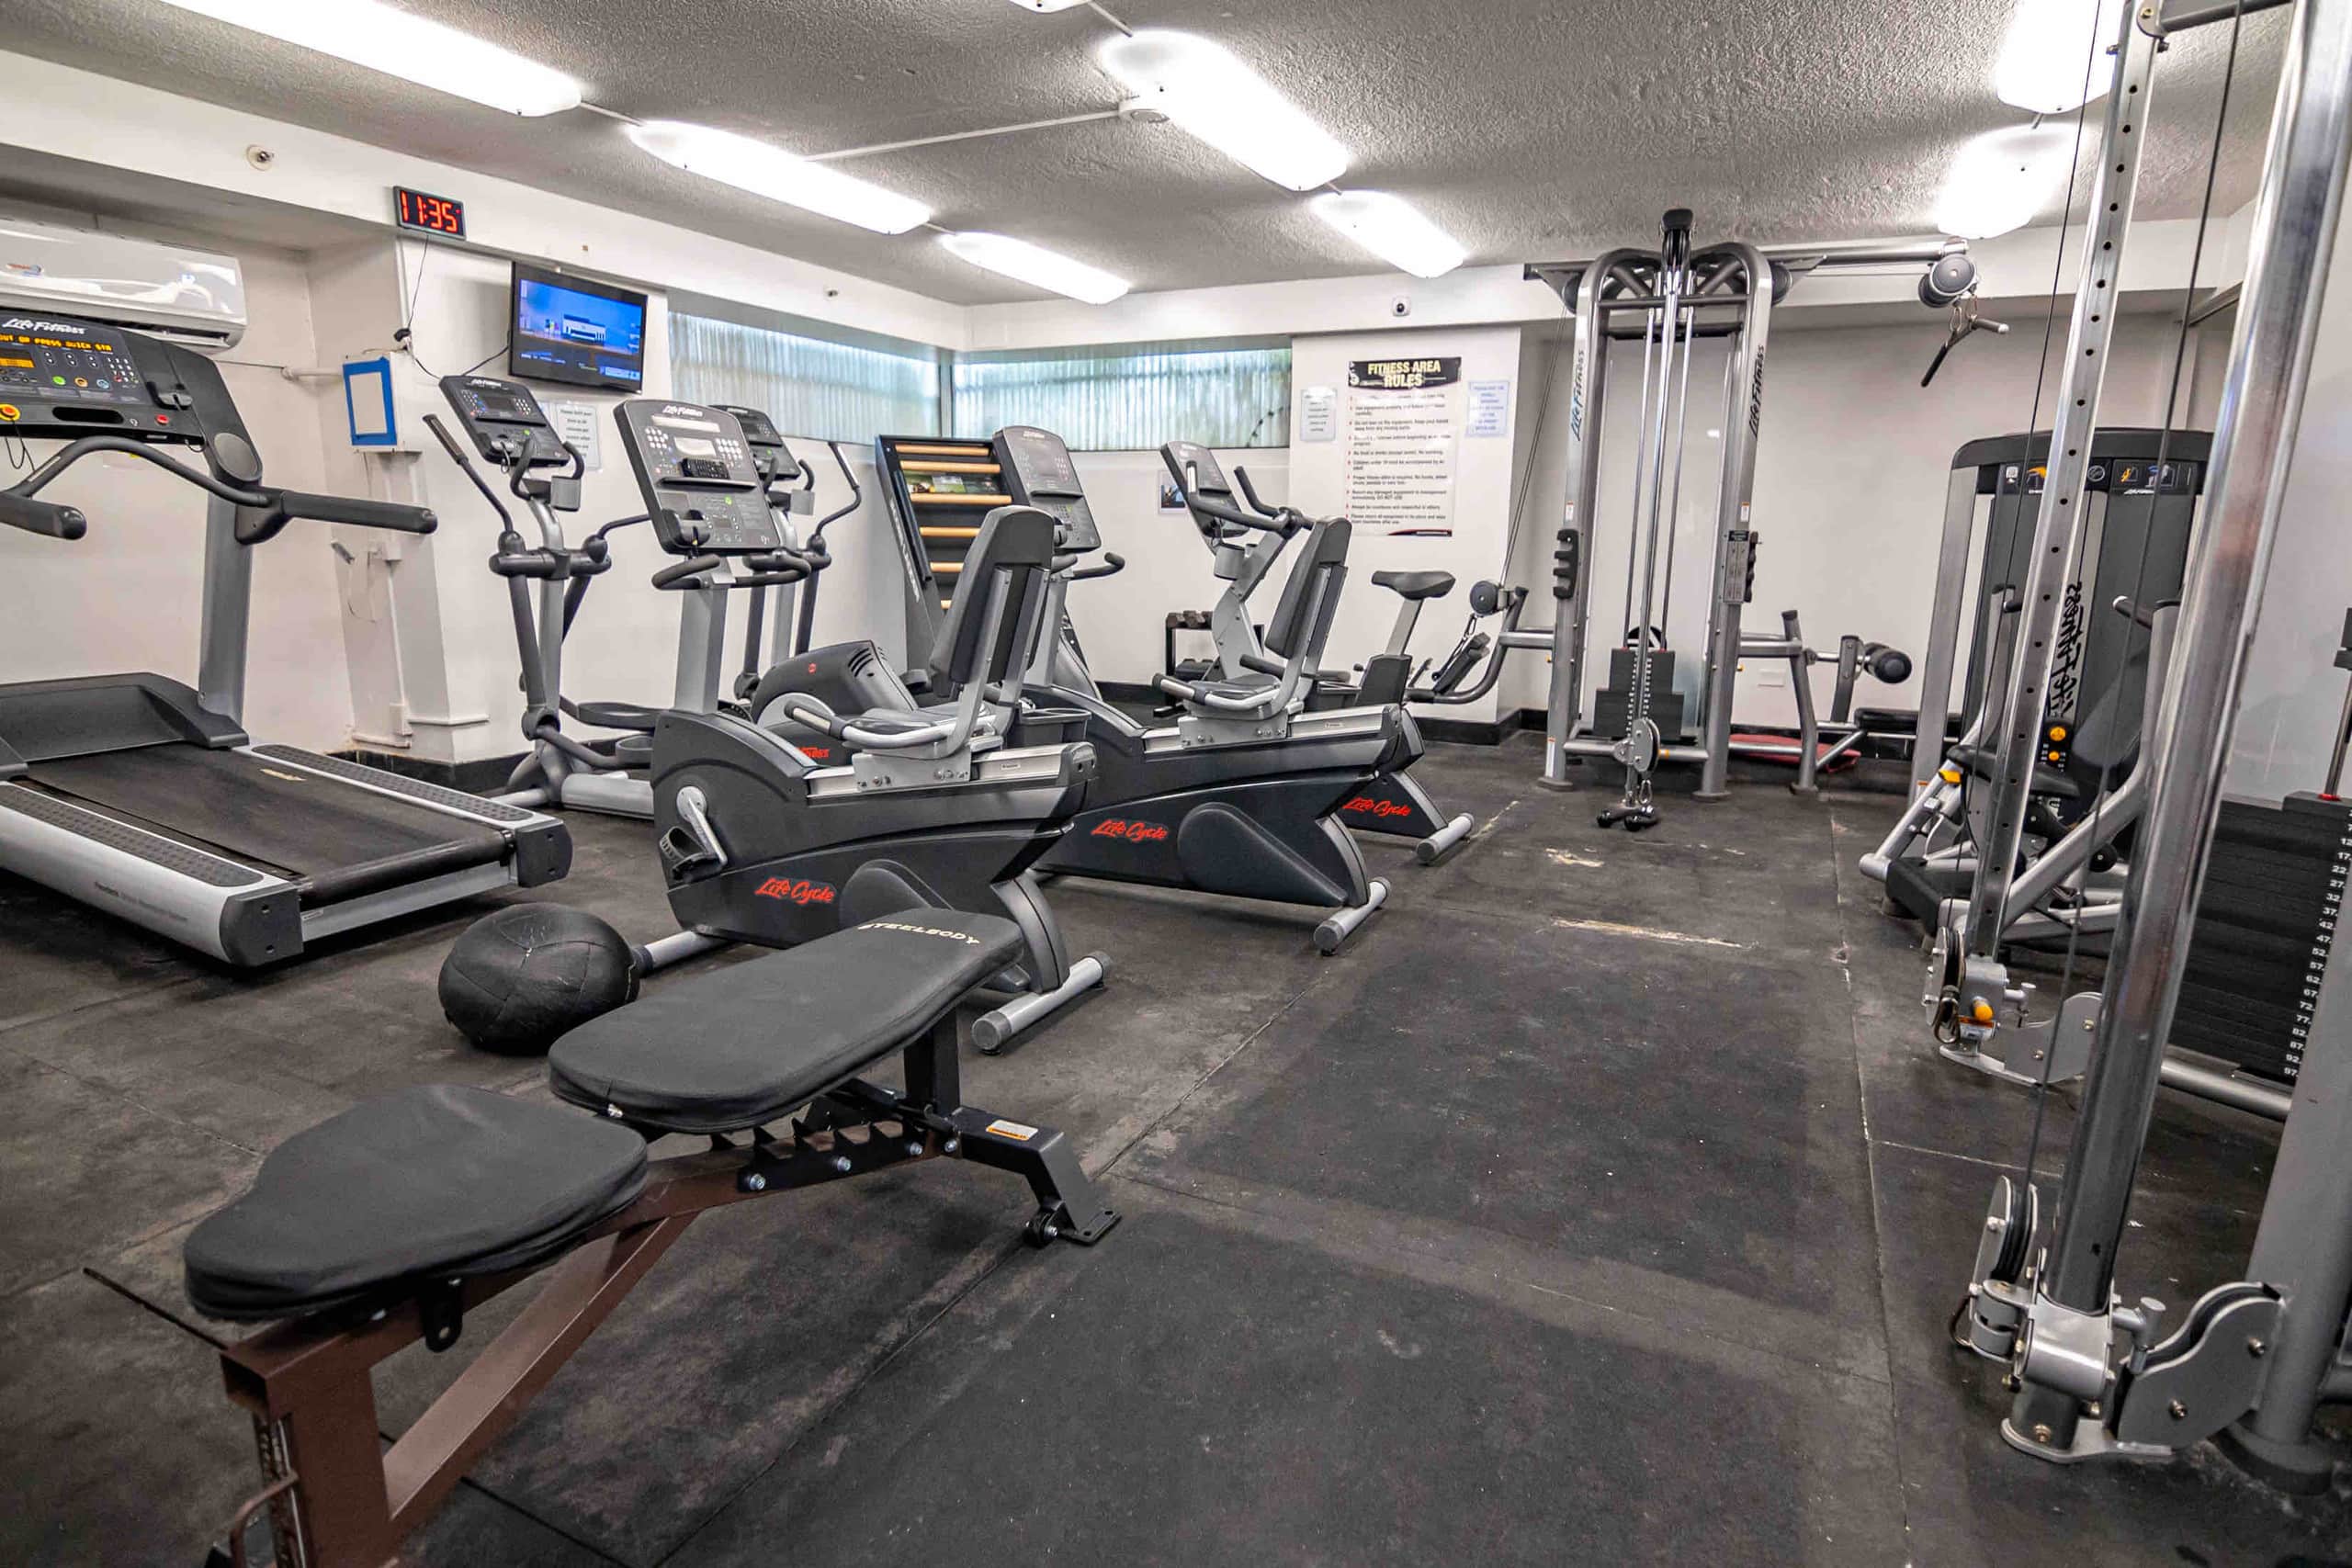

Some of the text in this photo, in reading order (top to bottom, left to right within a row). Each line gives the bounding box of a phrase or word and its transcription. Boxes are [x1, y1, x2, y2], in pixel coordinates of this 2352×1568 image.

[401, 190, 458, 232] 11:35
[2, 318, 85, 334] Life Fitness
[1367, 360, 1442, 376] FITNESS AREA
[1384, 373, 1424, 388] RULES
[1342, 796, 1411, 818] Life Cycle
[1091, 819, 1168, 842] Life Cycle
[754, 876, 834, 905] Life Cycle
[857, 923, 979, 944] STEELBODY
